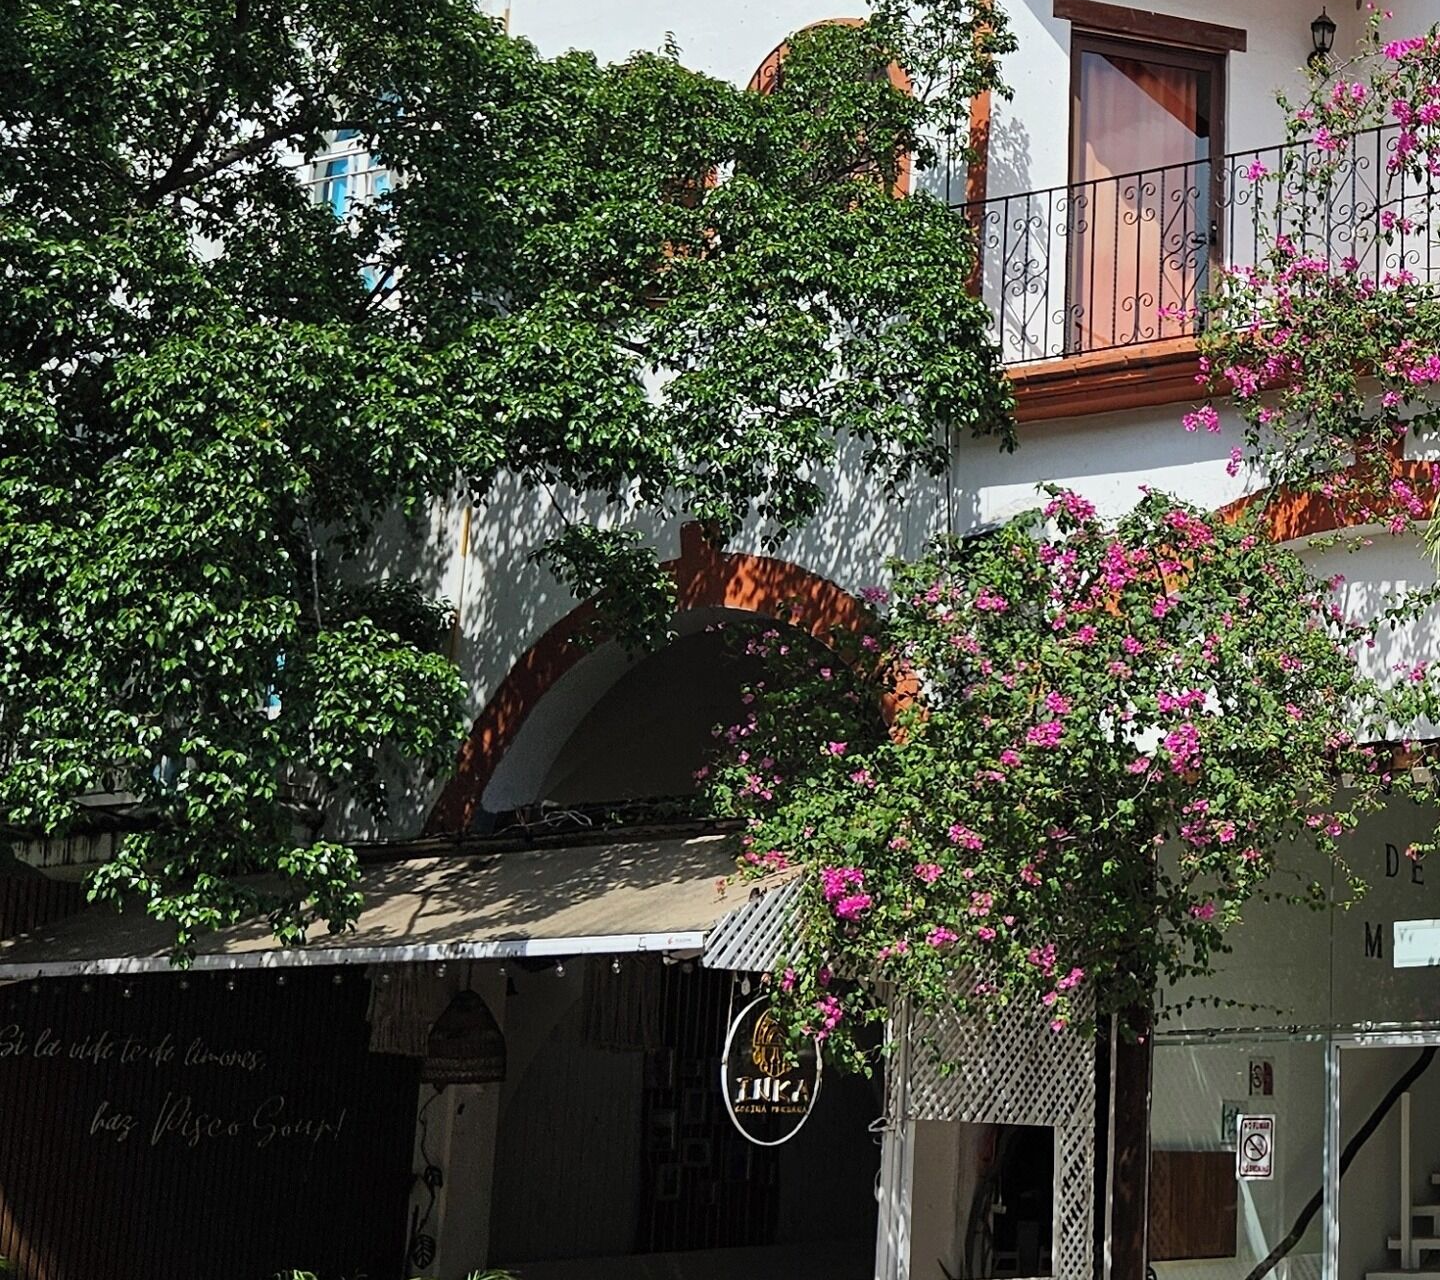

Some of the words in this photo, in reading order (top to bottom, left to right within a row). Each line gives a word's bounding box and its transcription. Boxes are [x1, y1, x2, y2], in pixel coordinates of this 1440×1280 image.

[33, 1027, 62, 1057] la
[69, 1030, 114, 1064] vida
[120, 1034, 147, 1063] te
[735, 1076, 809, 1102] INKA
[90, 1101, 139, 1142] haz
[151, 1091, 241, 1147] Pisco
[253, 1096, 347, 1148] Sour!
